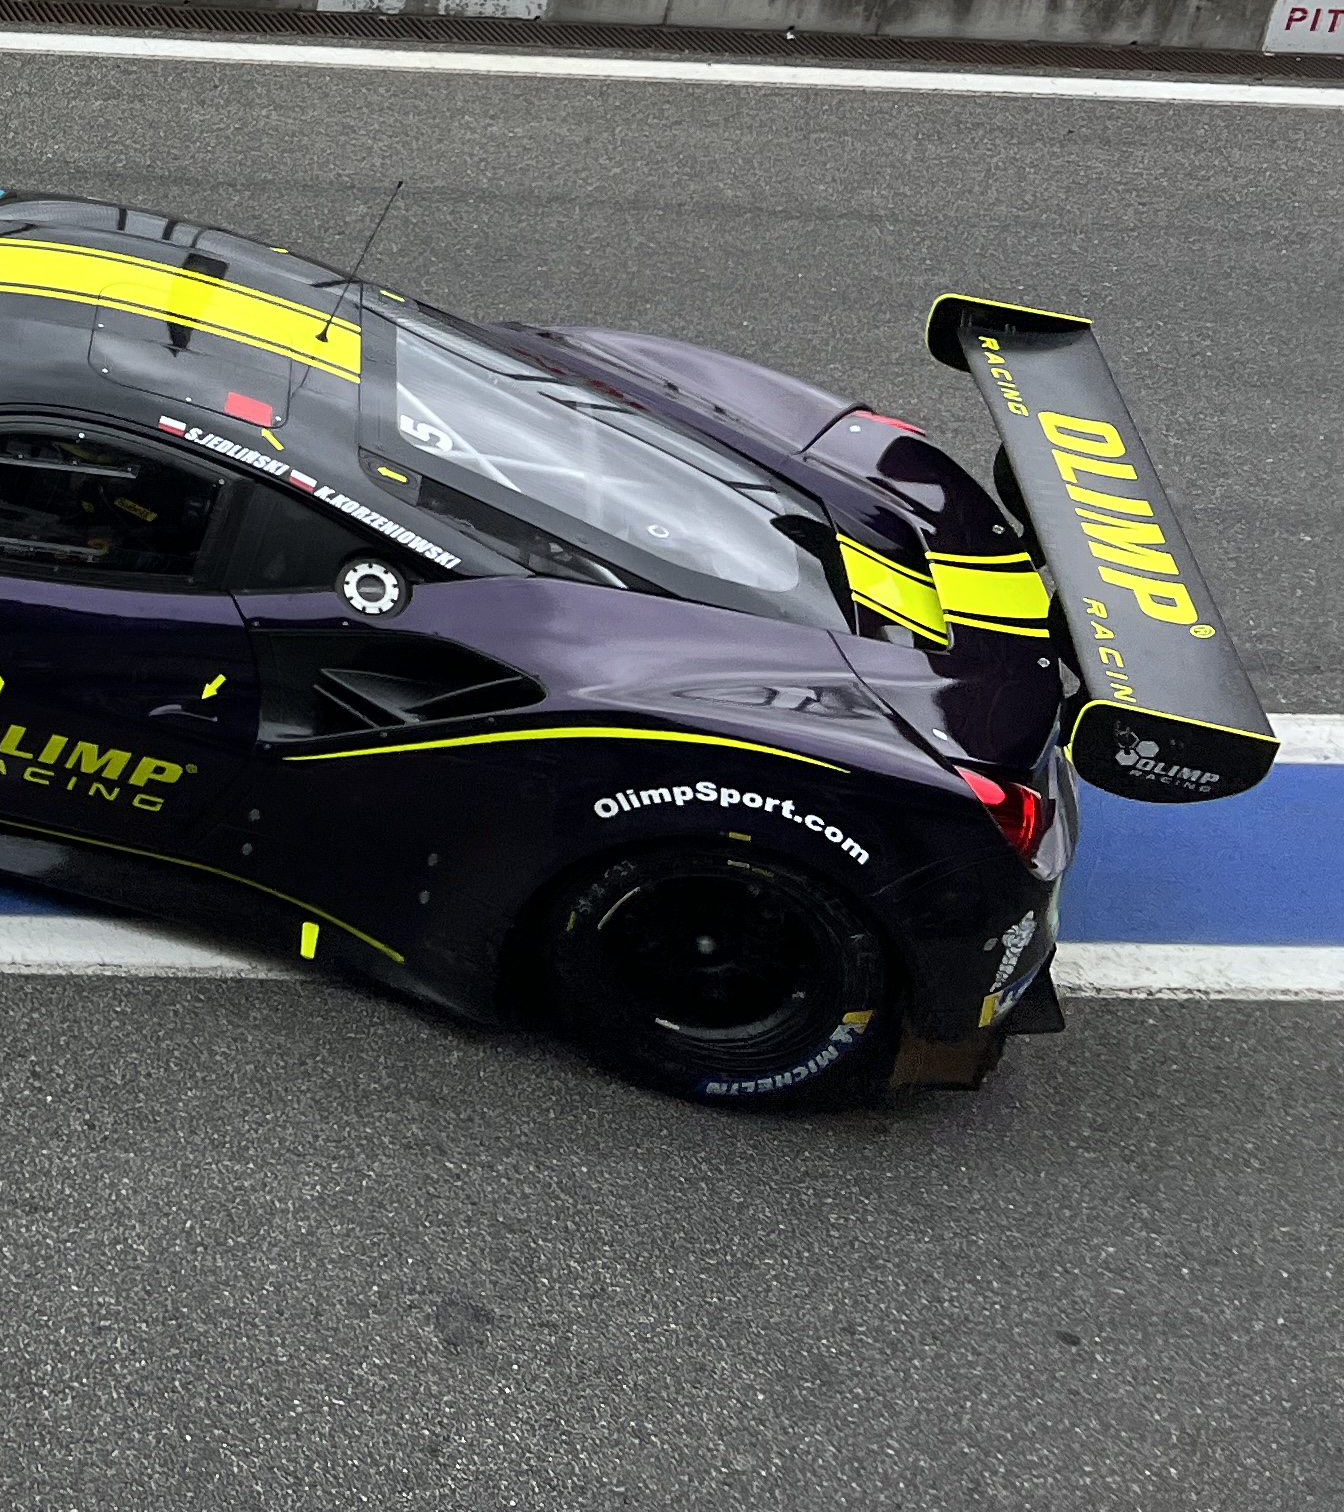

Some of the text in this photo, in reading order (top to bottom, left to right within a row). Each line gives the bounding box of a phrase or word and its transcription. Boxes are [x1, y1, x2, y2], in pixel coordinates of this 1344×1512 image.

[1285, 7, 1344, 32] PIT
[978, 335, 1029, 418] RACING
[1037, 409, 1199, 626] OLIMP
[1083, 596, 1137, 704] RACIN
[1135, 756, 1220, 786] OLIMP
[593, 780, 871, 865] OlimpSport.com
[705, 1044, 840, 1096] MICHELIN
